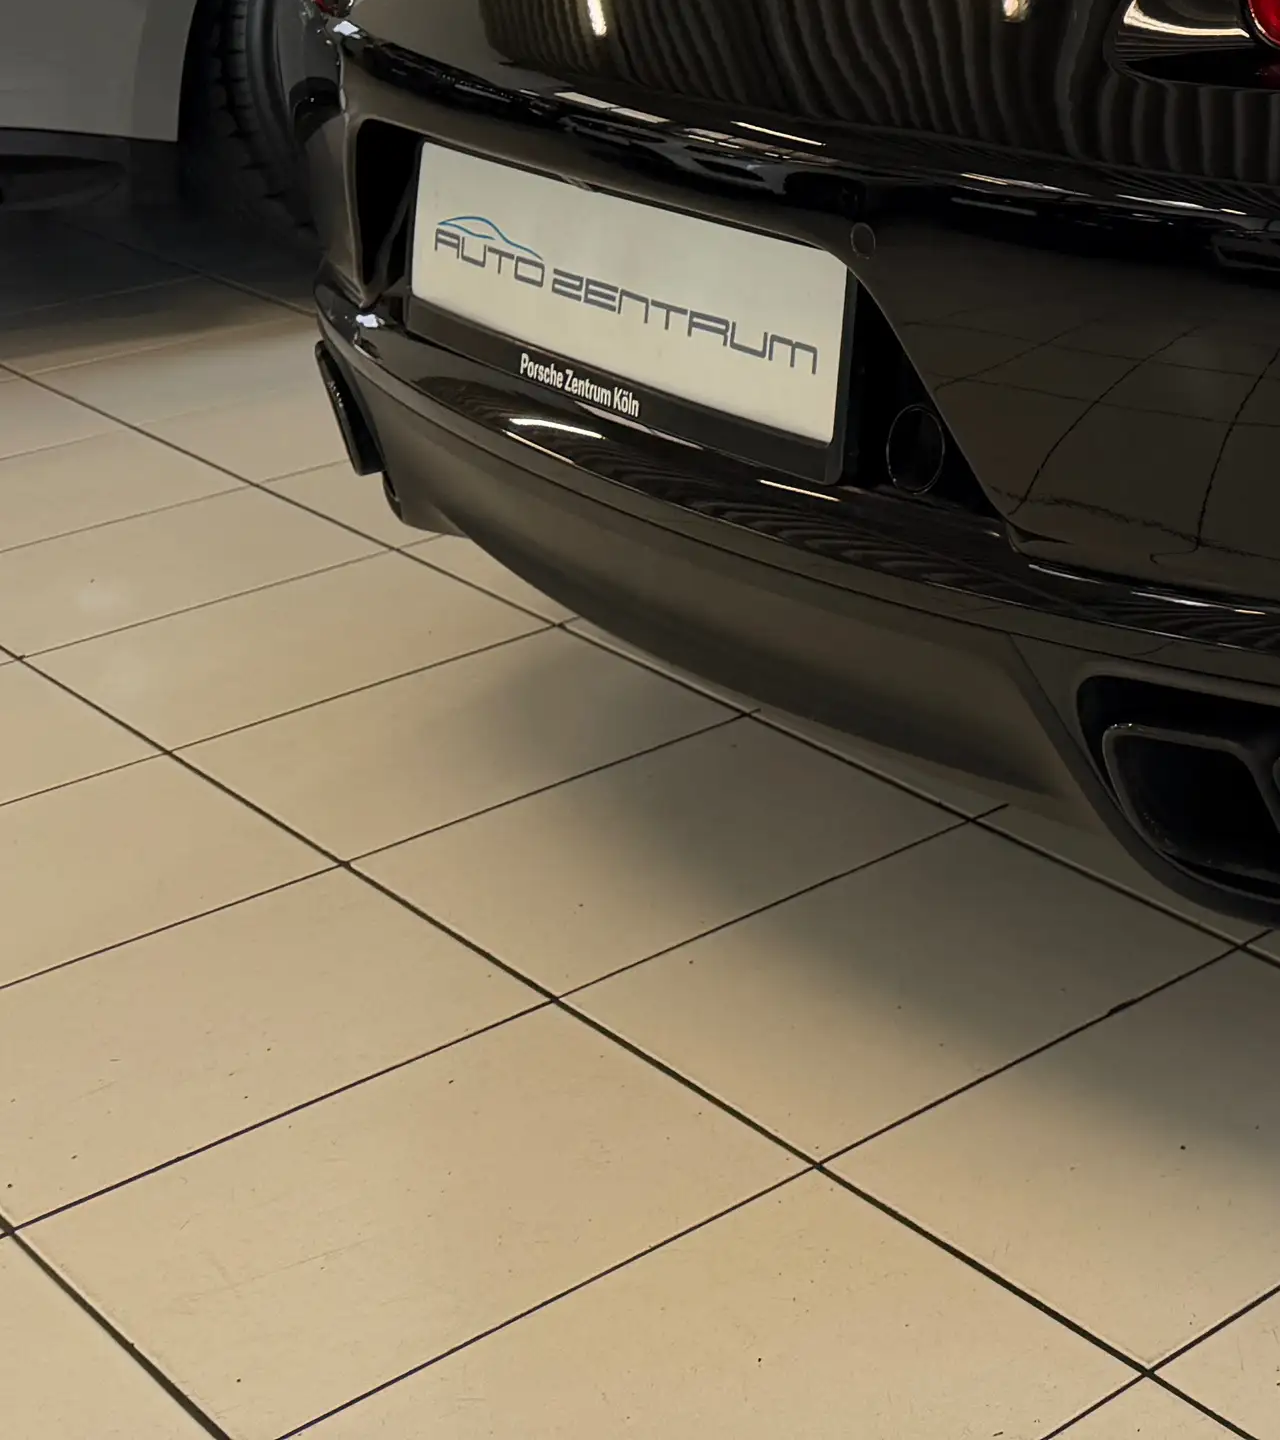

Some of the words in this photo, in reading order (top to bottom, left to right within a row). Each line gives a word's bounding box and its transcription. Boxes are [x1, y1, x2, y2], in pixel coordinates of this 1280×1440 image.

[434, 227, 545, 286] AUTO
[552, 267, 819, 376] ZENTRUM
[520, 352, 563, 389] Porsche
[564, 368, 611, 408] Zentrum
[613, 386, 640, 418] Köln
